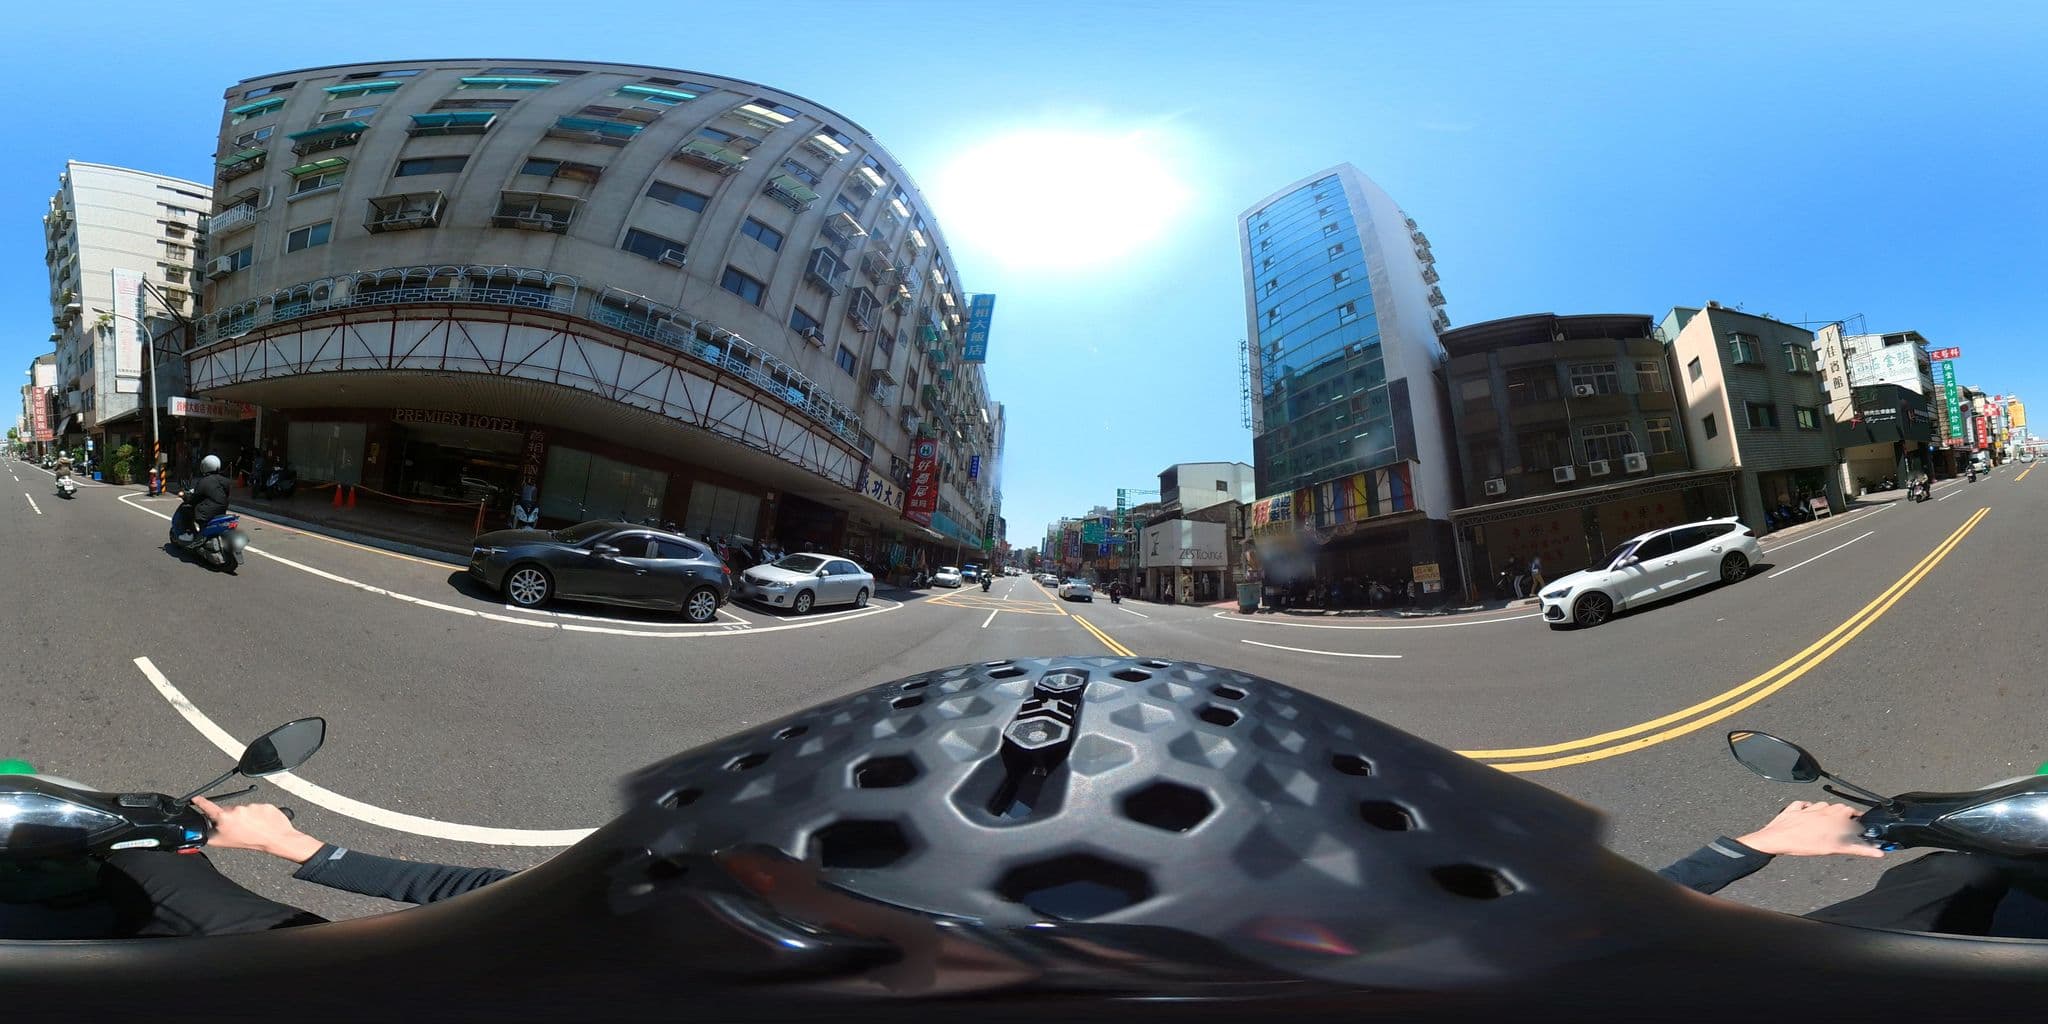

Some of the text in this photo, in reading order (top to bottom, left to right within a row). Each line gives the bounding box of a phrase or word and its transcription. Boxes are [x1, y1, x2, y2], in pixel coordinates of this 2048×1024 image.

[395, 408, 521, 432] PREMIER HOTEL
[1178, 548, 1201, 560] ZEST
